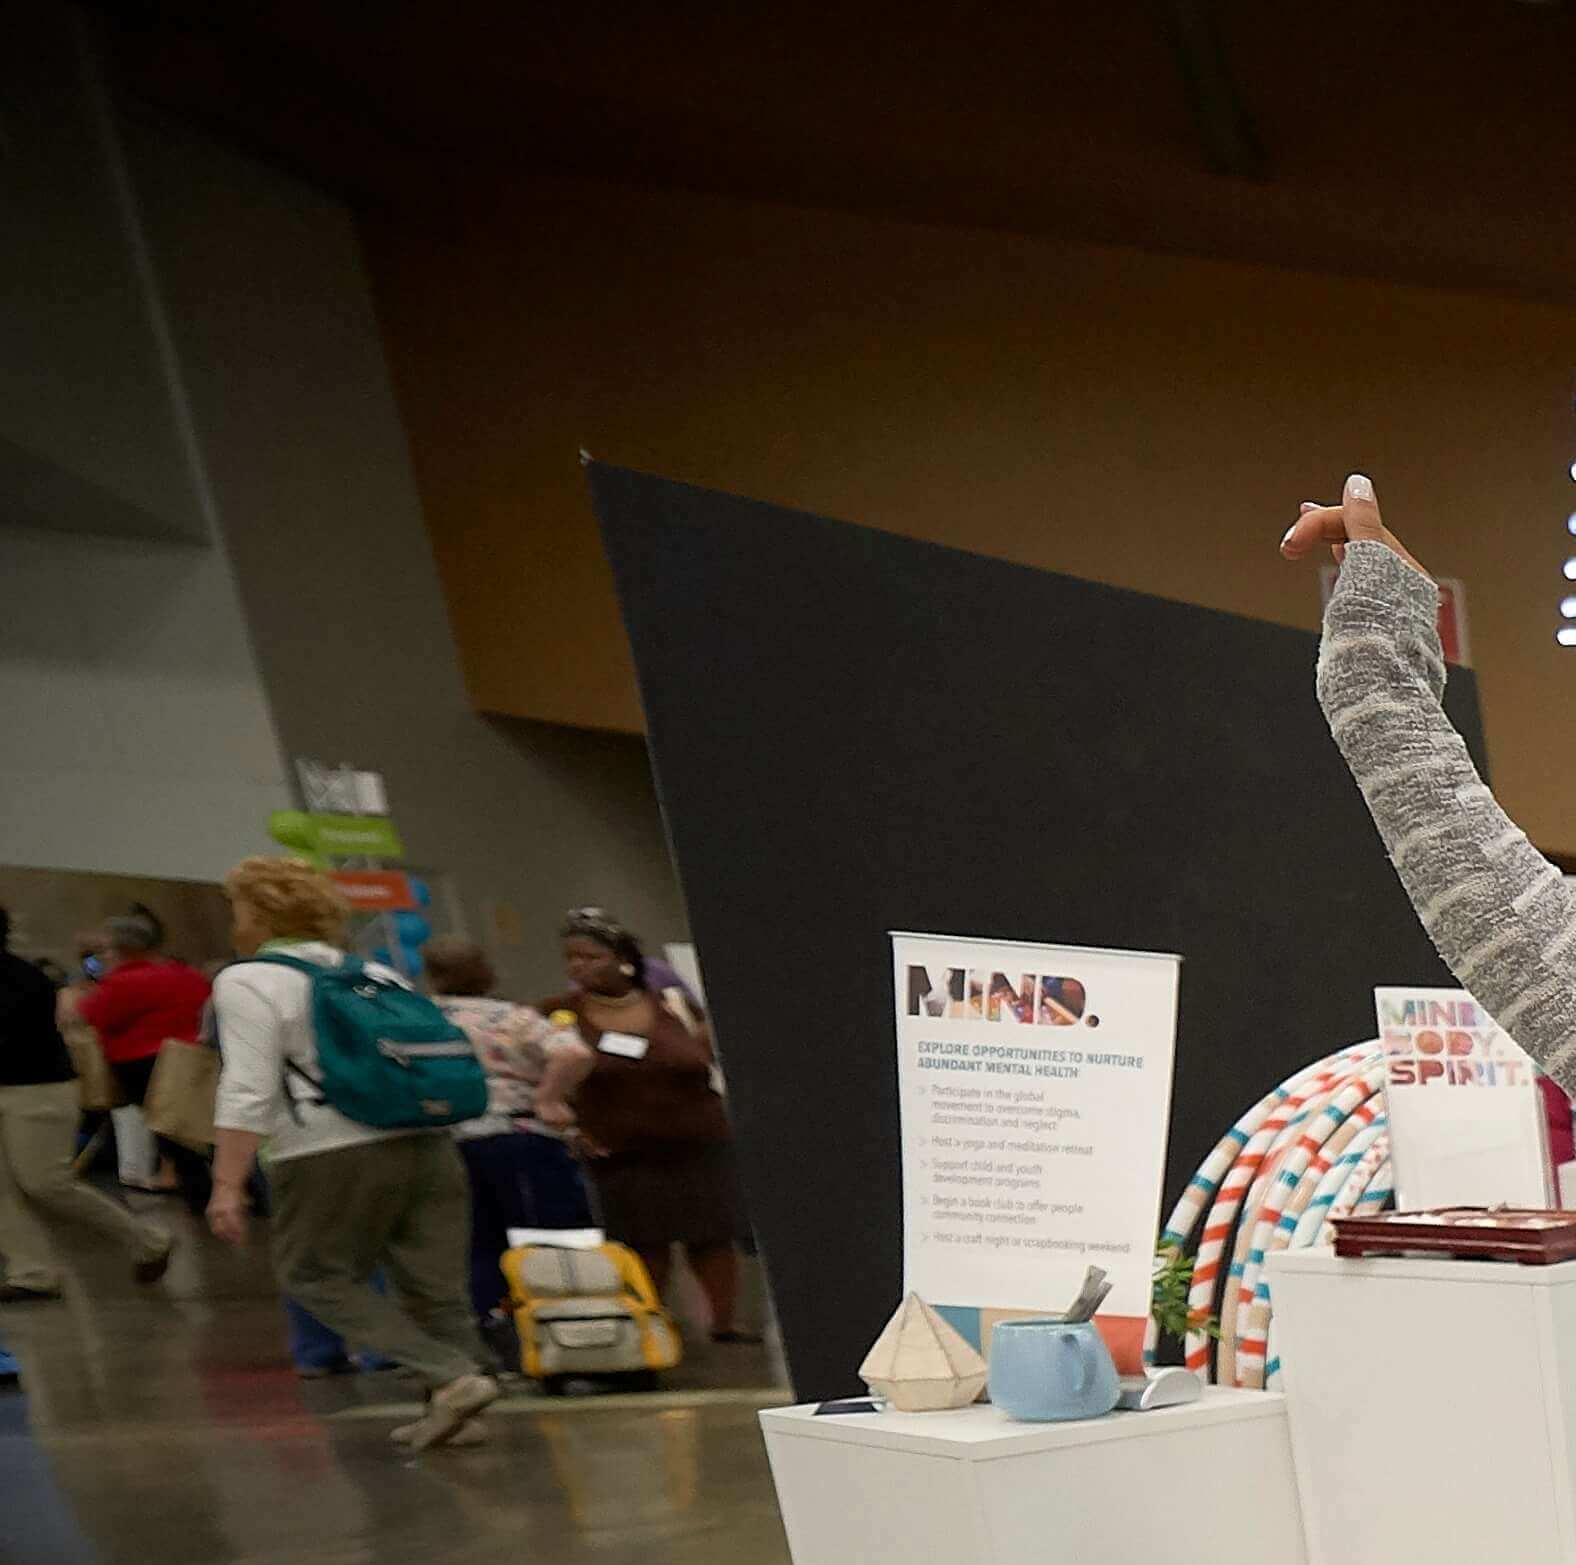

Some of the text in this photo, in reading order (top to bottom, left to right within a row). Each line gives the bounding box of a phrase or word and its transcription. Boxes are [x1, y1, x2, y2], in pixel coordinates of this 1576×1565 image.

[917, 1040, 1143, 1069] EXPLORE OPPORTUNITIES TO NURTURE
[917, 1057, 1079, 1079] ABUNDANT MENTAL HEALTH
